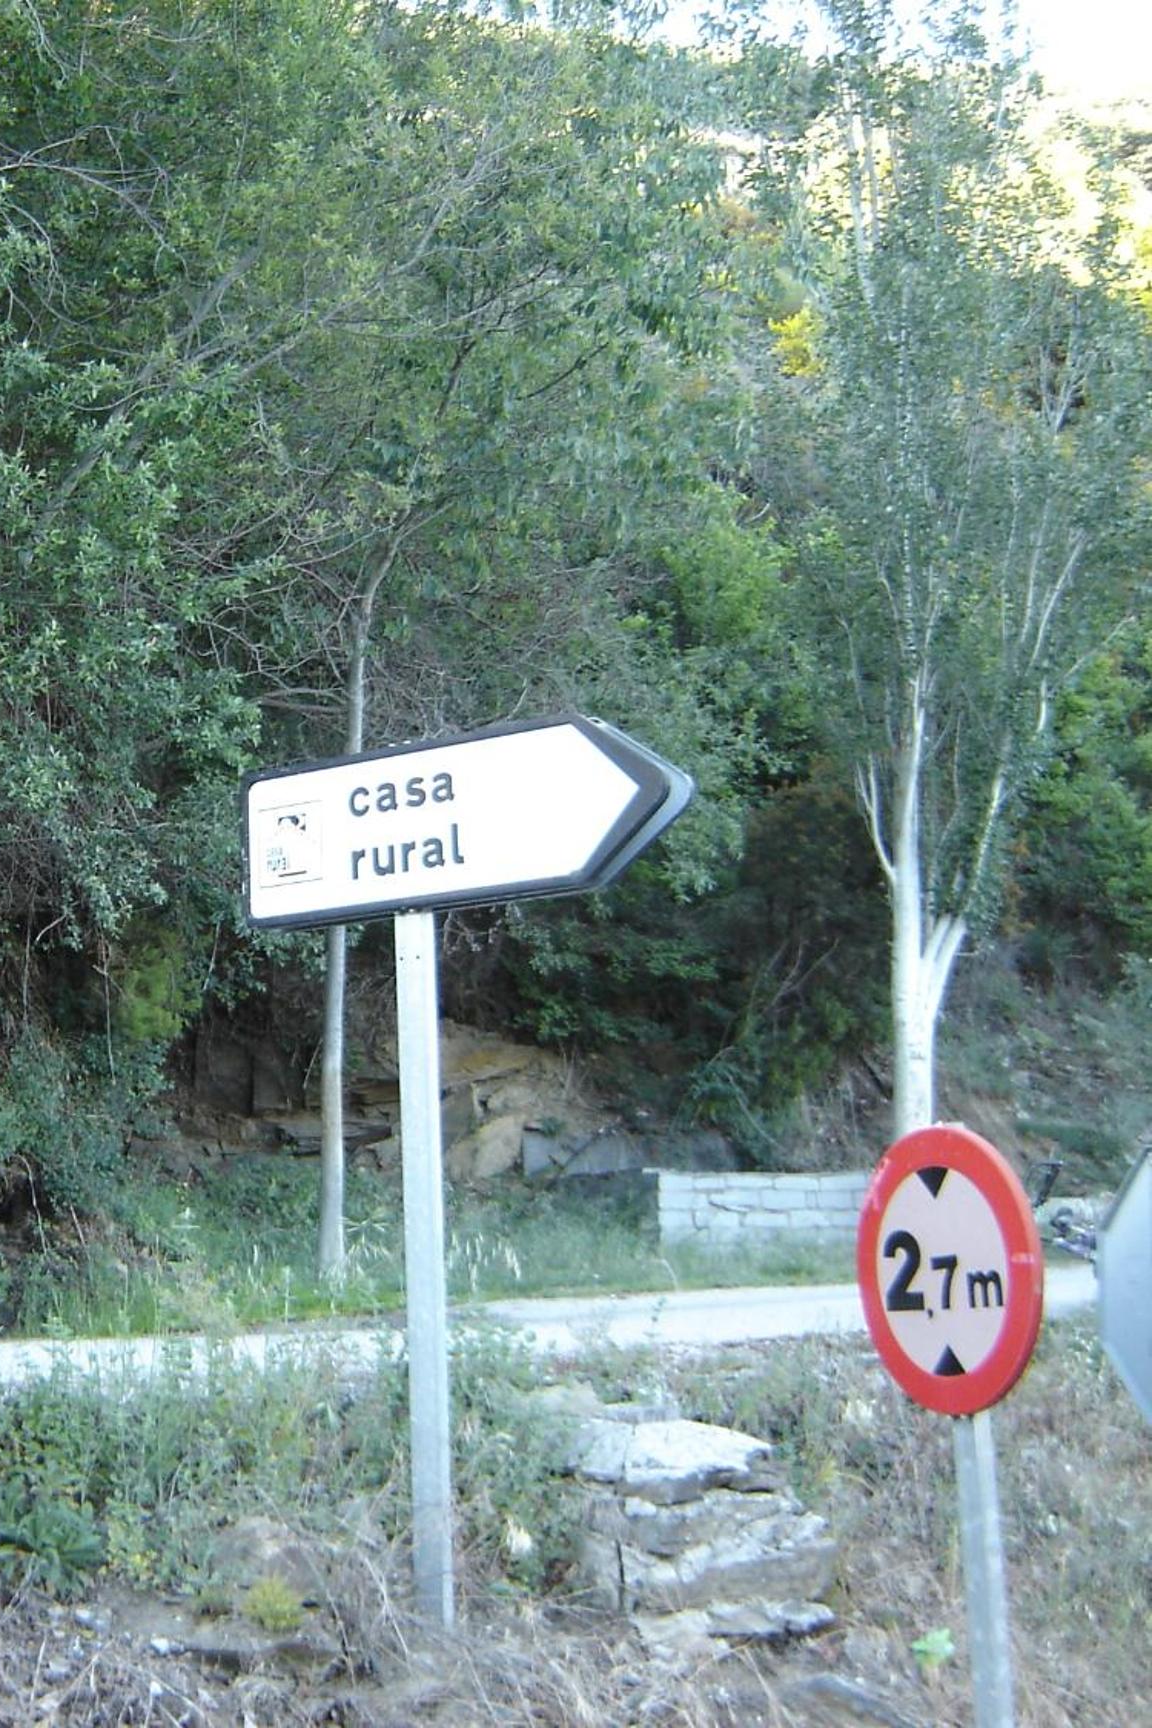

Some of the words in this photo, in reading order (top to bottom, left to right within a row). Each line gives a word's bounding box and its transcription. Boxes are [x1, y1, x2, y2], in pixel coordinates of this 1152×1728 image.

[350, 772, 455, 816] casa
[352, 824, 465, 880] rural
[883, 1230, 959, 1319] 2,7
[967, 1269, 1004, 1309] m
